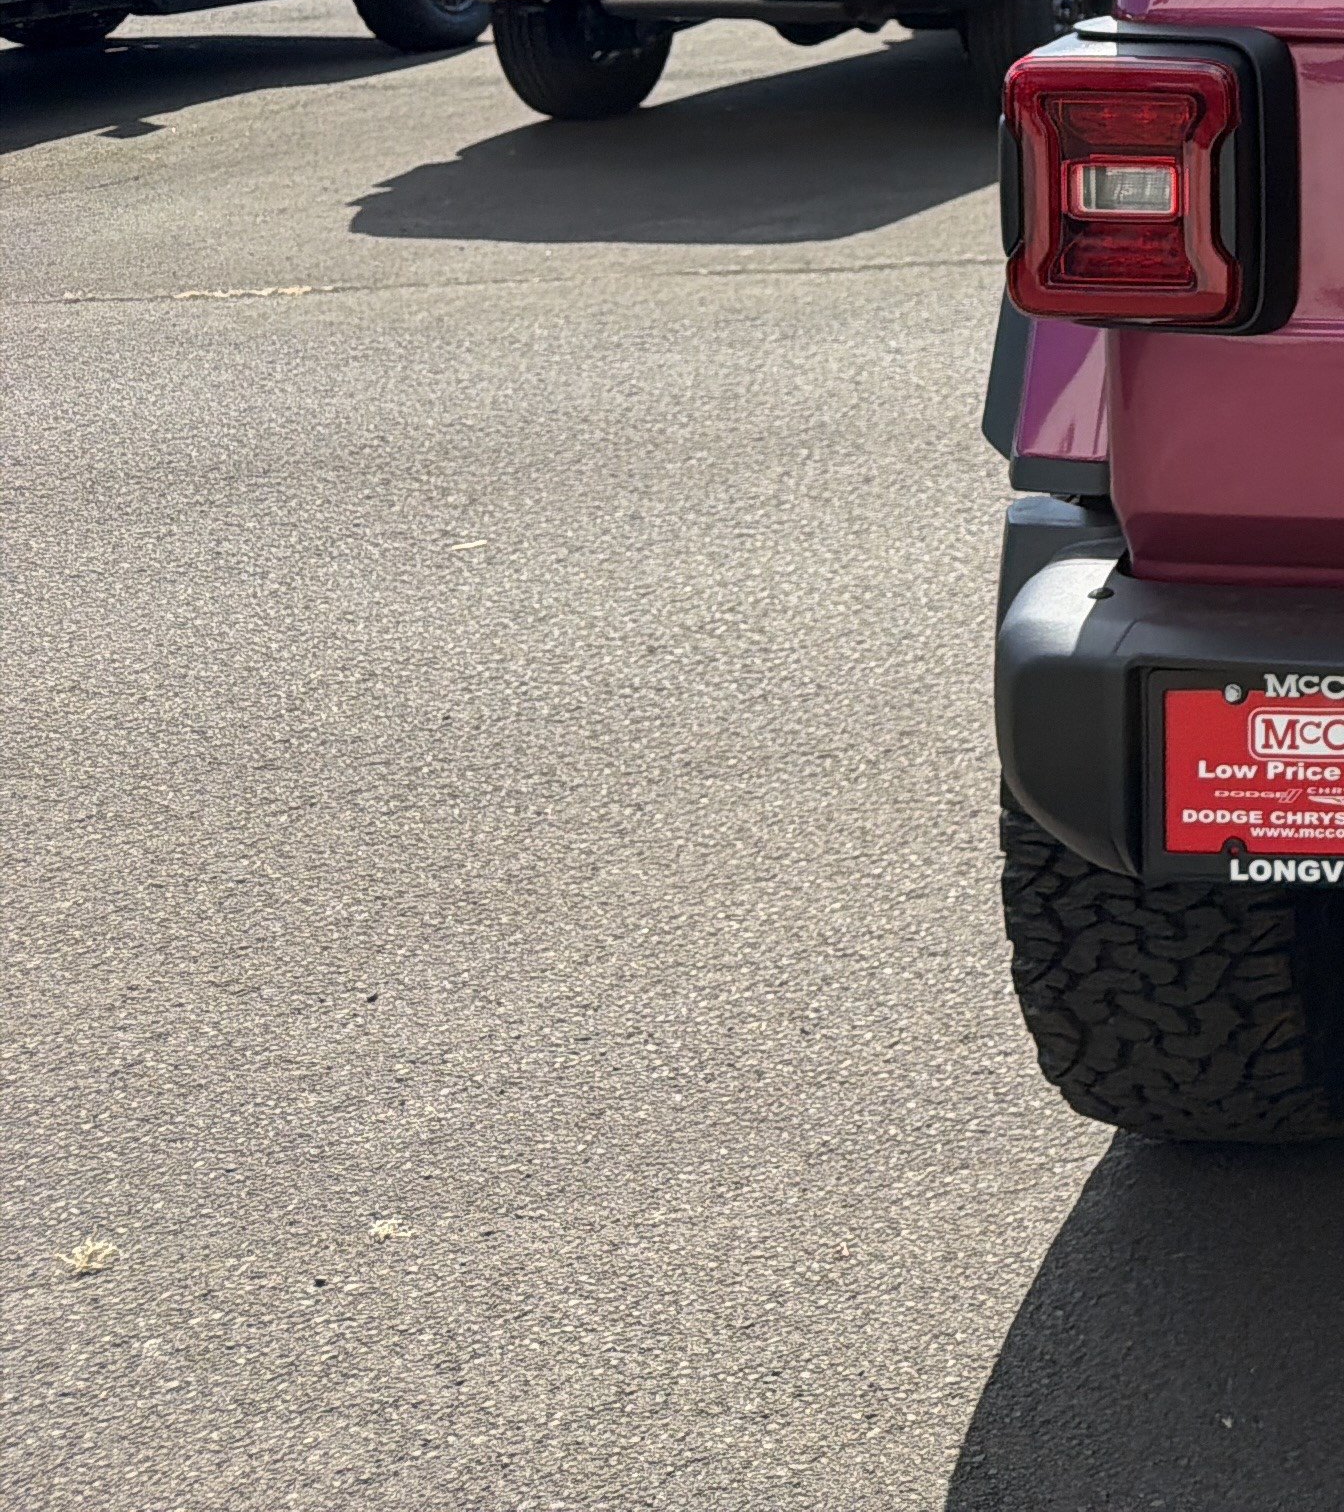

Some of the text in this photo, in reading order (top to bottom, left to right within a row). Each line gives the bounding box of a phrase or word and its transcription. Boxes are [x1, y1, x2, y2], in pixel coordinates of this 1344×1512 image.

[1198, 760, 1257, 779] Low
[1267, 762, 1341, 781] Price
[1214, 790, 1288, 799] DODGE
[1182, 809, 1263, 824] DODGE
